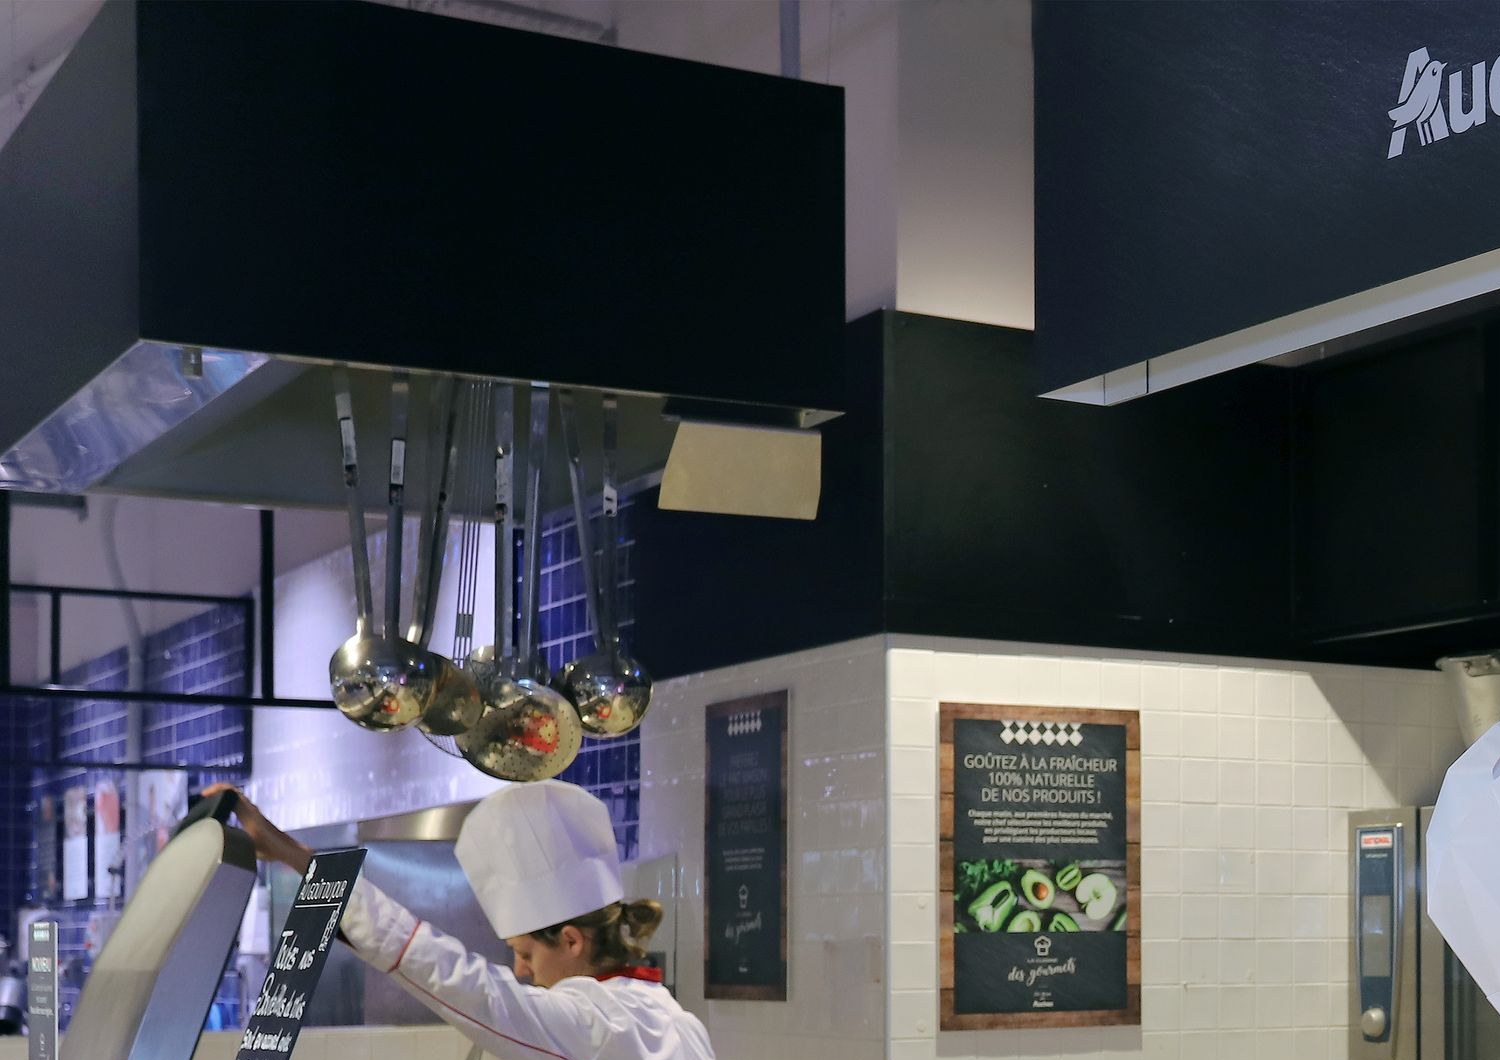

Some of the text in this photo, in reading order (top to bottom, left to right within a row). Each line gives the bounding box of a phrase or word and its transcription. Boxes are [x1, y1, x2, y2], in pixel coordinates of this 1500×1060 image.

[963, 752, 1118, 772] GOÛTEZ À LA FRAÎCHEUR
[988, 771, 1095, 788] 100% NATURELLE
[981, 787, 999, 802] DE
[1002, 788, 1031, 803] NOS
[1033, 789, 1095, 804] PRODUITS
[1026, 957, 1076, 987] gourmets
